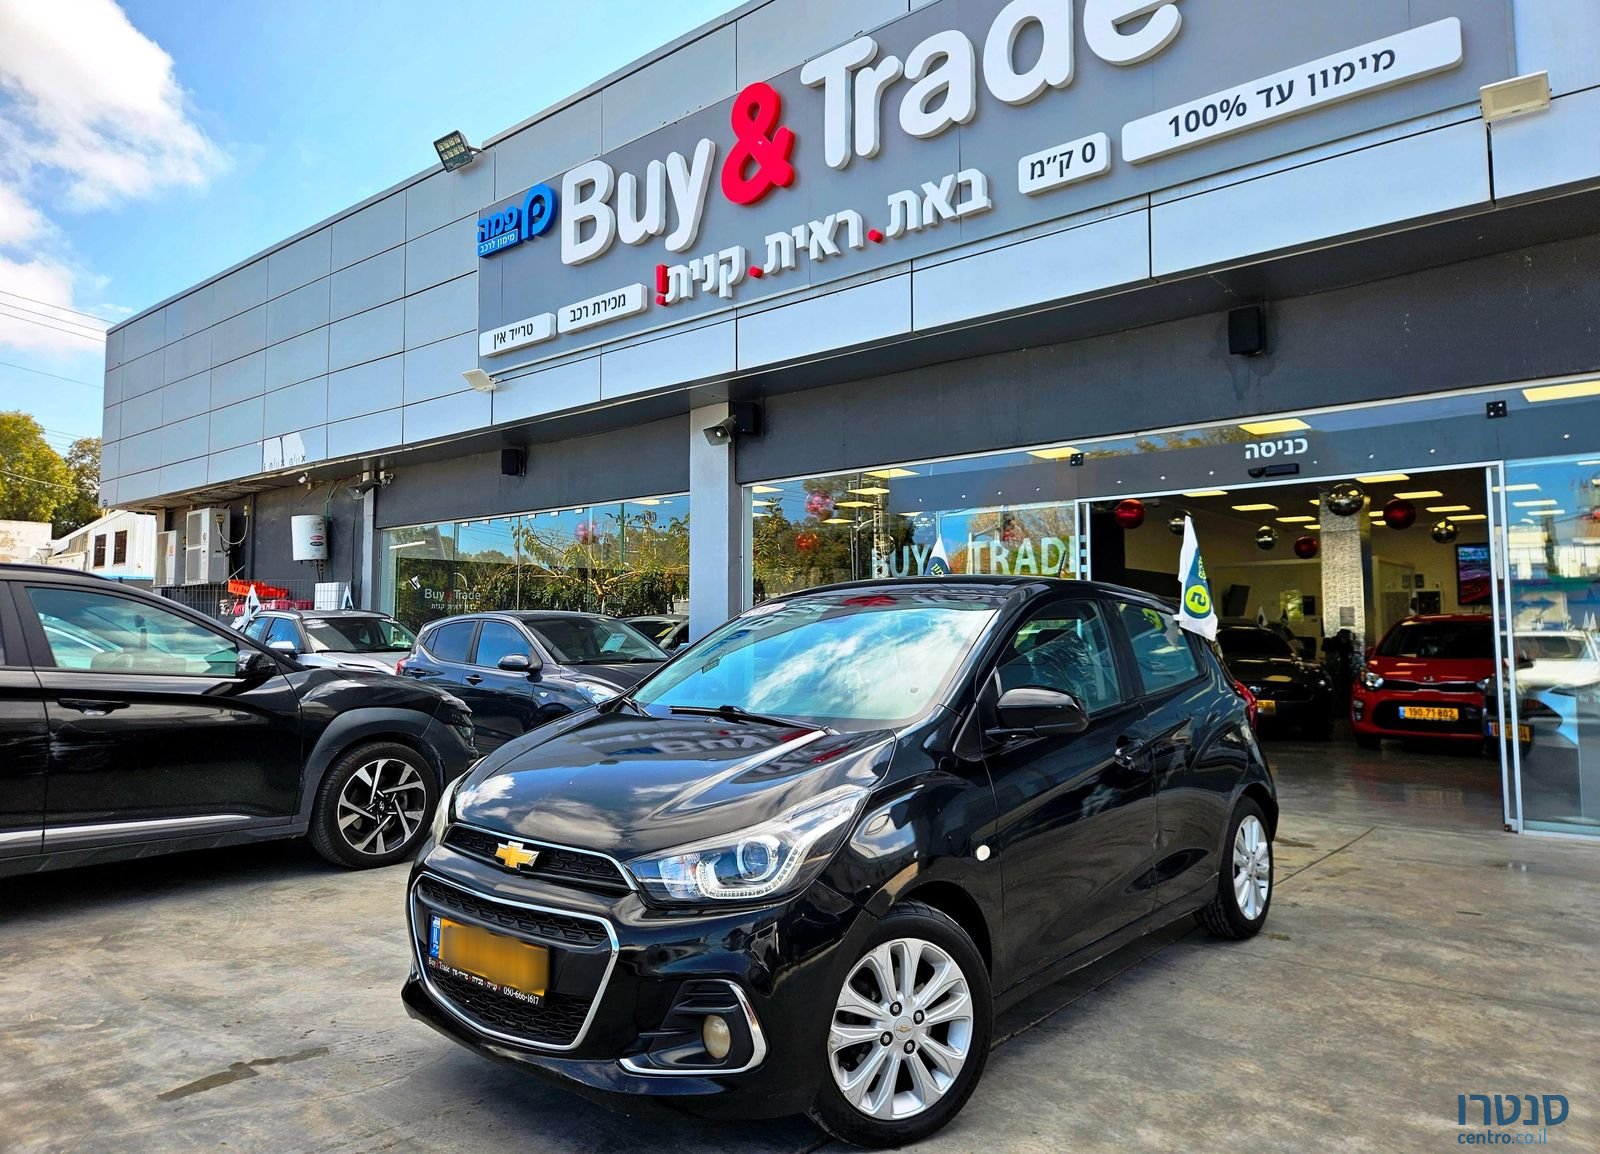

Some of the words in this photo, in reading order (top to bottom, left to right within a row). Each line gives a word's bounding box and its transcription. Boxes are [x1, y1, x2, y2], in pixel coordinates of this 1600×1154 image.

[1307, 48, 1396, 97] מימון
[1256, 79, 1295, 109] עד
[1167, 94, 1247, 138] 100%
[561, 138, 716, 266] Buy
[721, 81, 795, 206] &
[800, 0, 1182, 170] Trade
[1081, 141, 1096, 164] 0
[480, 240, 496, 254] לרכב
[497, 233, 515, 248] מימון
[569, 305, 589, 323] רכב
[592, 293, 626, 316] מכירת
[493, 330, 507, 350] אין
[509, 322, 534, 341] טרייד
[1244, 437, 1309, 460] כניסה
[424, 588, 445, 601] Buy
[453, 588, 481, 600] Trade
